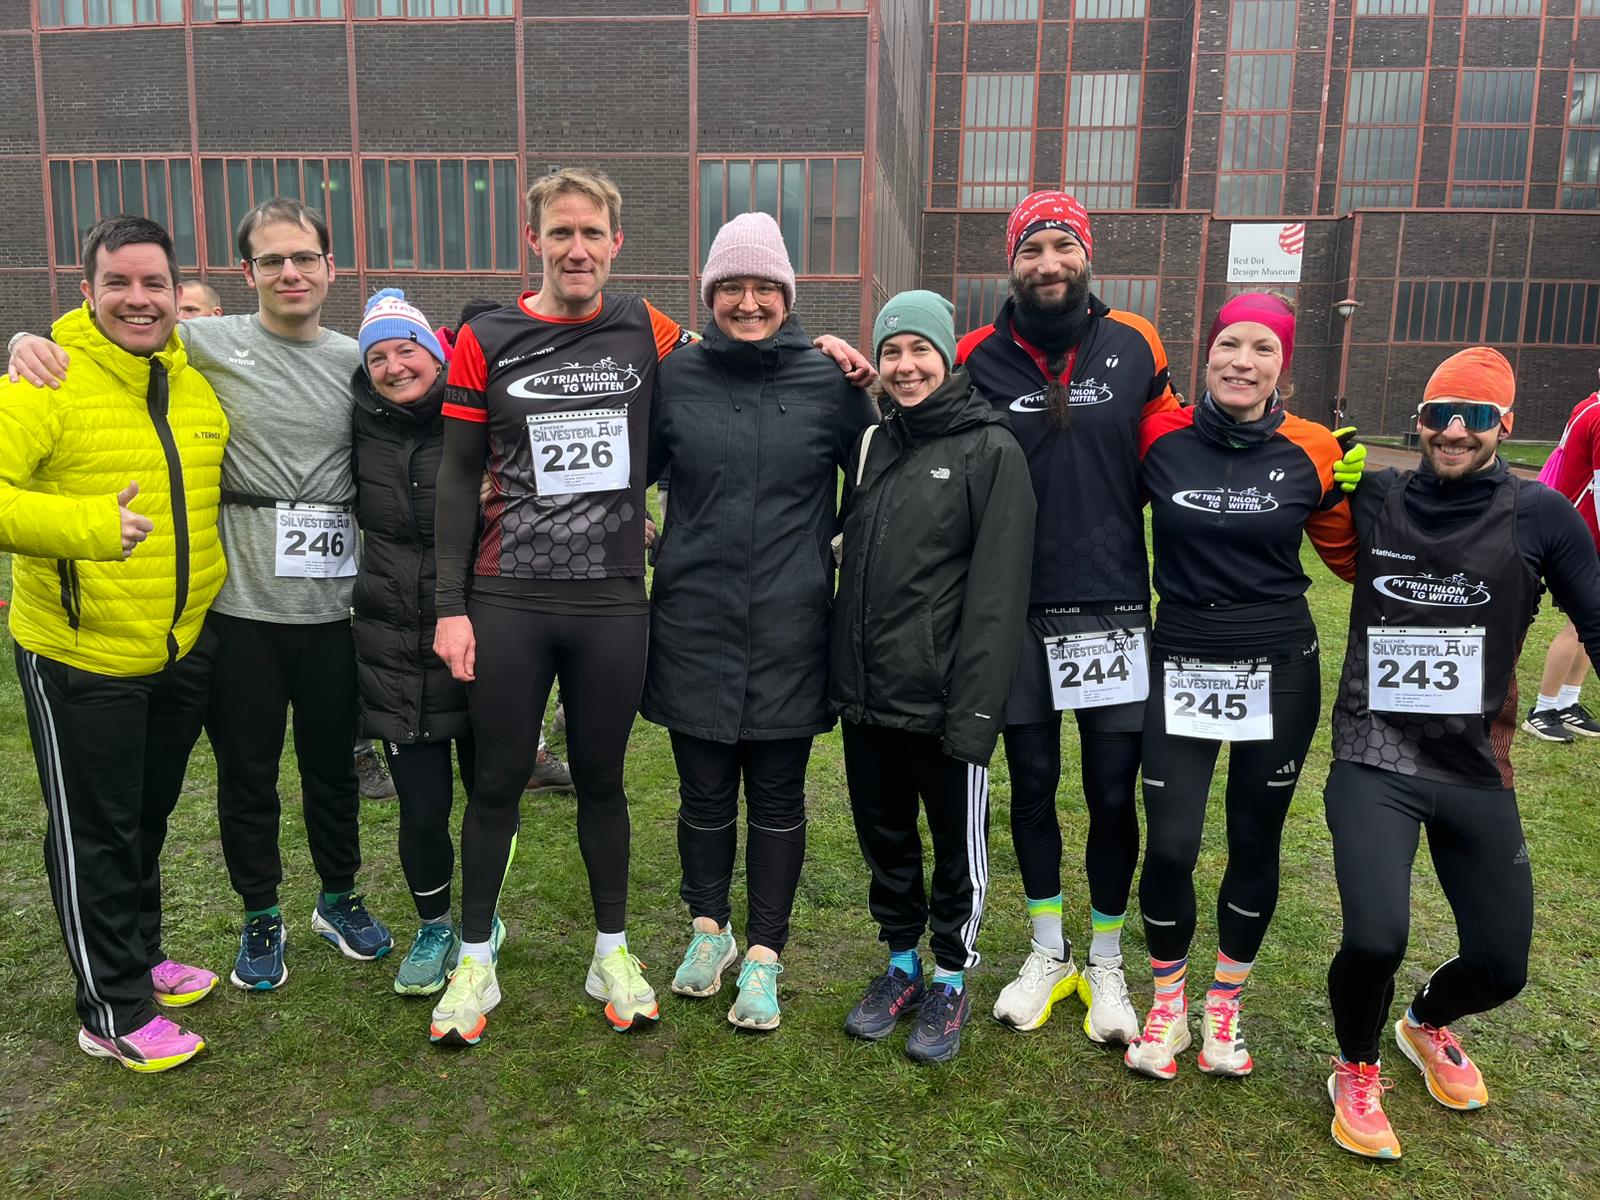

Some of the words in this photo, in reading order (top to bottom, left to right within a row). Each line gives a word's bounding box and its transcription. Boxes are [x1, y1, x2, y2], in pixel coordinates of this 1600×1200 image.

[1233, 257, 1248, 265] Red
[1250, 257, 1265, 265] Dot
[1232, 268, 1259, 278] Design
[1261, 268, 1295, 276] Museum
[229, 357, 256, 366] erima
[533, 376, 550, 387] PV
[552, 372, 618, 385] TRIATHLON
[562, 384, 579, 393] TG
[582, 381, 624, 392] WITTEN
[1024, 397, 1035, 405] PV
[541, 440, 613, 473] 226
[1189, 492, 1201, 500] PV
[1208, 501, 1220, 509] TG
[1228, 502, 1262, 511] WITTEN
[284, 530, 344, 557] 246
[1371, 548, 1416, 561] triathlon.one
[1392, 579, 1405, 588] PV
[1405, 581, 1465, 595] TRIATHLON
[1412, 590, 1426, 600] TG
[1428, 593, 1469, 604] WITTEN
[1045, 606, 1081, 614] HUUB
[1114, 604, 1144, 612] HUUB
[1058, 655, 1130, 689] 244
[1377, 659, 1460, 691] 243
[1173, 692, 1248, 720] 245
